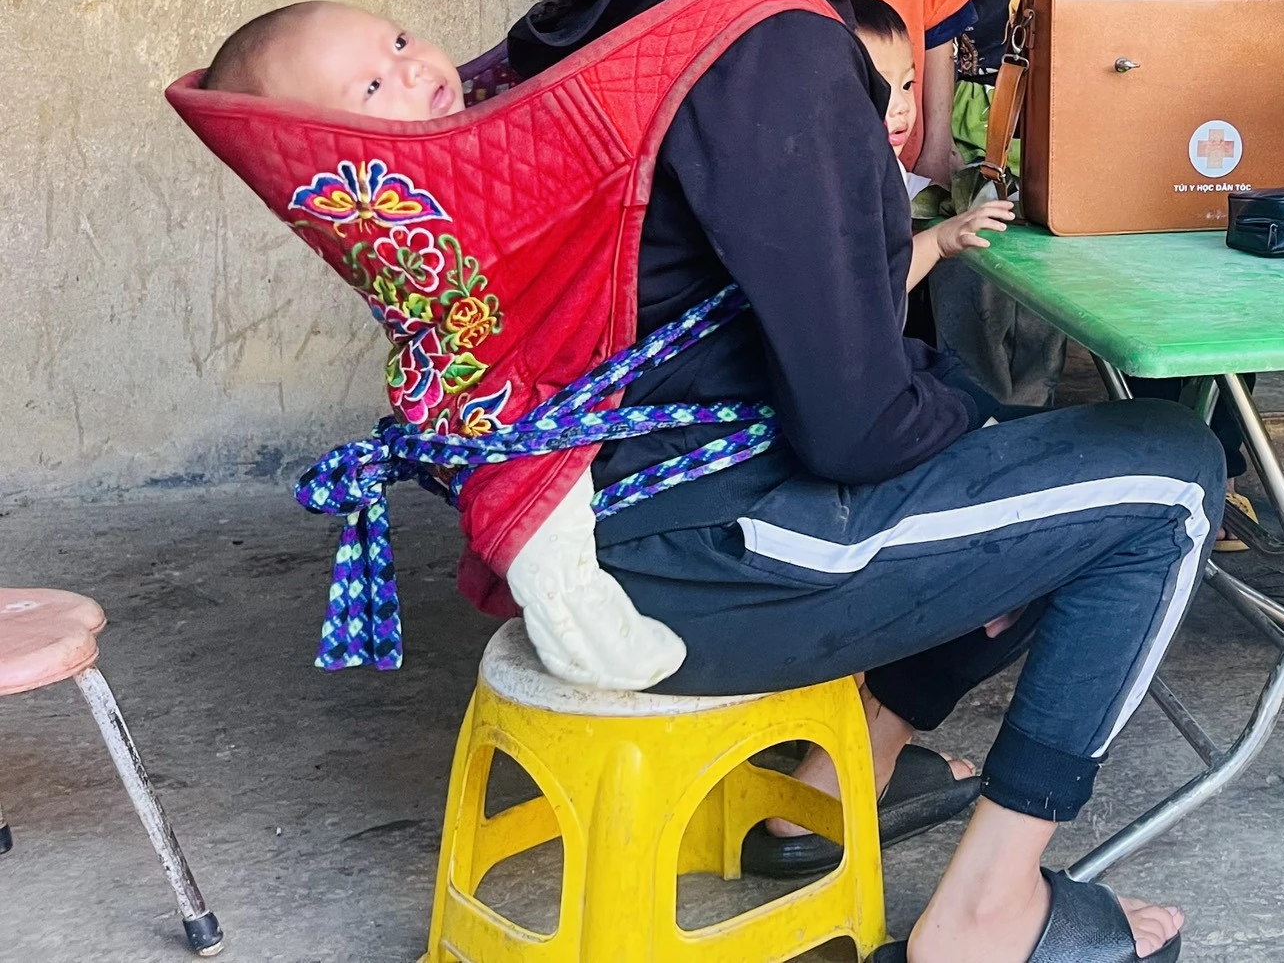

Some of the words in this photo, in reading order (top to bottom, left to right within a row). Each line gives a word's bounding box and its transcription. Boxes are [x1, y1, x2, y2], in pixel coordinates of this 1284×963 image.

[1174, 183, 1188, 192] TÚI
[1189, 184, 1196, 192] Y
[1196, 184, 1214, 193] HỌC
[1215, 182, 1234, 191] DÂN
